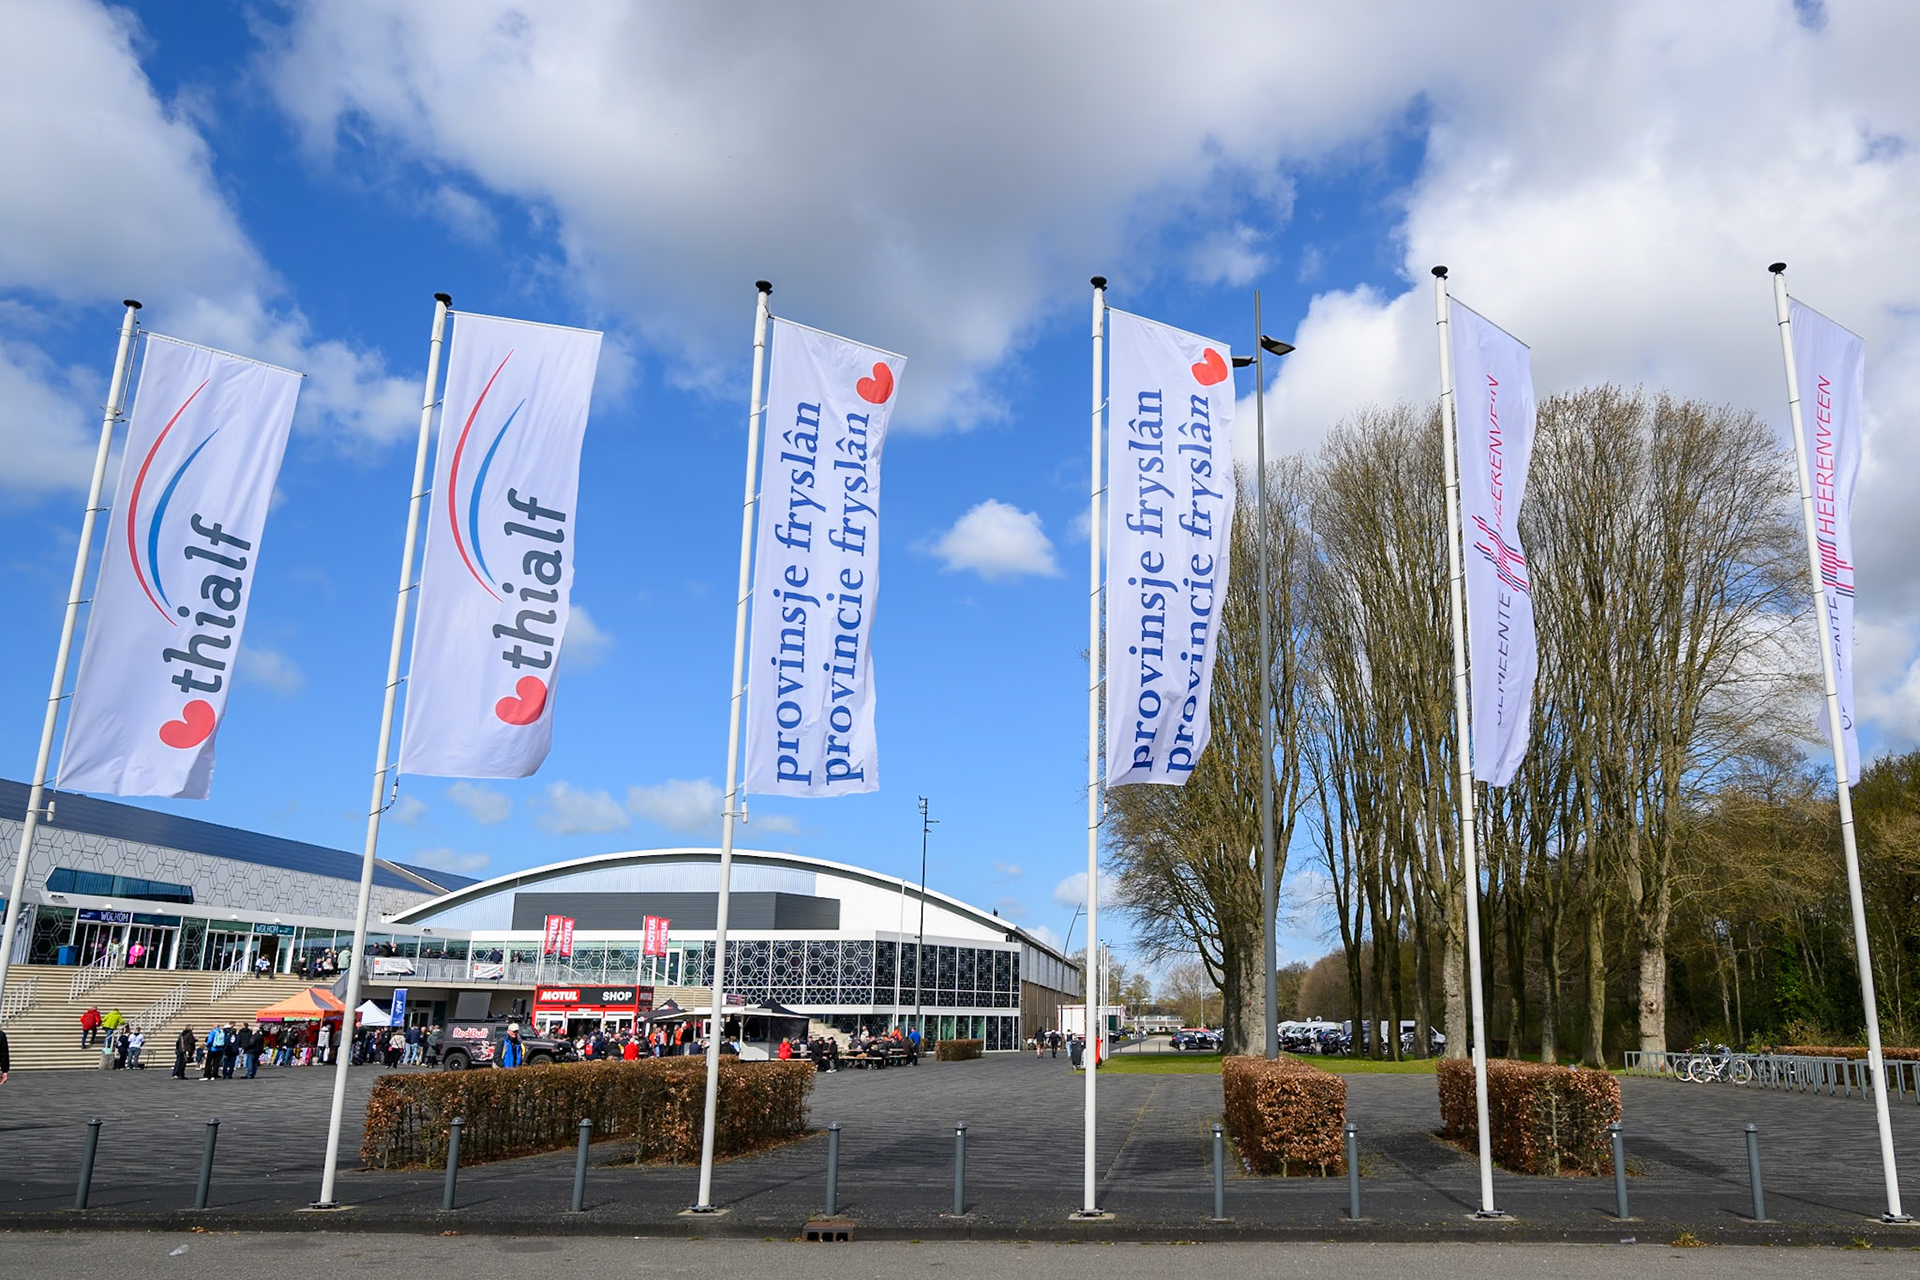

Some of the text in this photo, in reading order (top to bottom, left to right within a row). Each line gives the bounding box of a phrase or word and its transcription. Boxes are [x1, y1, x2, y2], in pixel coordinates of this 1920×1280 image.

[1486, 374, 1503, 533] HEERENVEN
[1815, 374, 1835, 536] HEERENVEEN
[163, 513, 252, 694] thialf
[492, 488, 566, 670] thialf
[771, 402, 826, 786] provinsje fryslân
[823, 413, 877, 786] provincie fryslân
[1127, 389, 1178, 772] provinsje fryslân
[1166, 396, 1223, 773] provincie fryslân
[541, 990, 578, 1001] MOTUL
[602, 990, 632, 1001] SHOP
[562, 920, 573, 953] MOTUL
[647, 918, 656, 951] MOTUL
[660, 921, 668, 953] MOTUL
